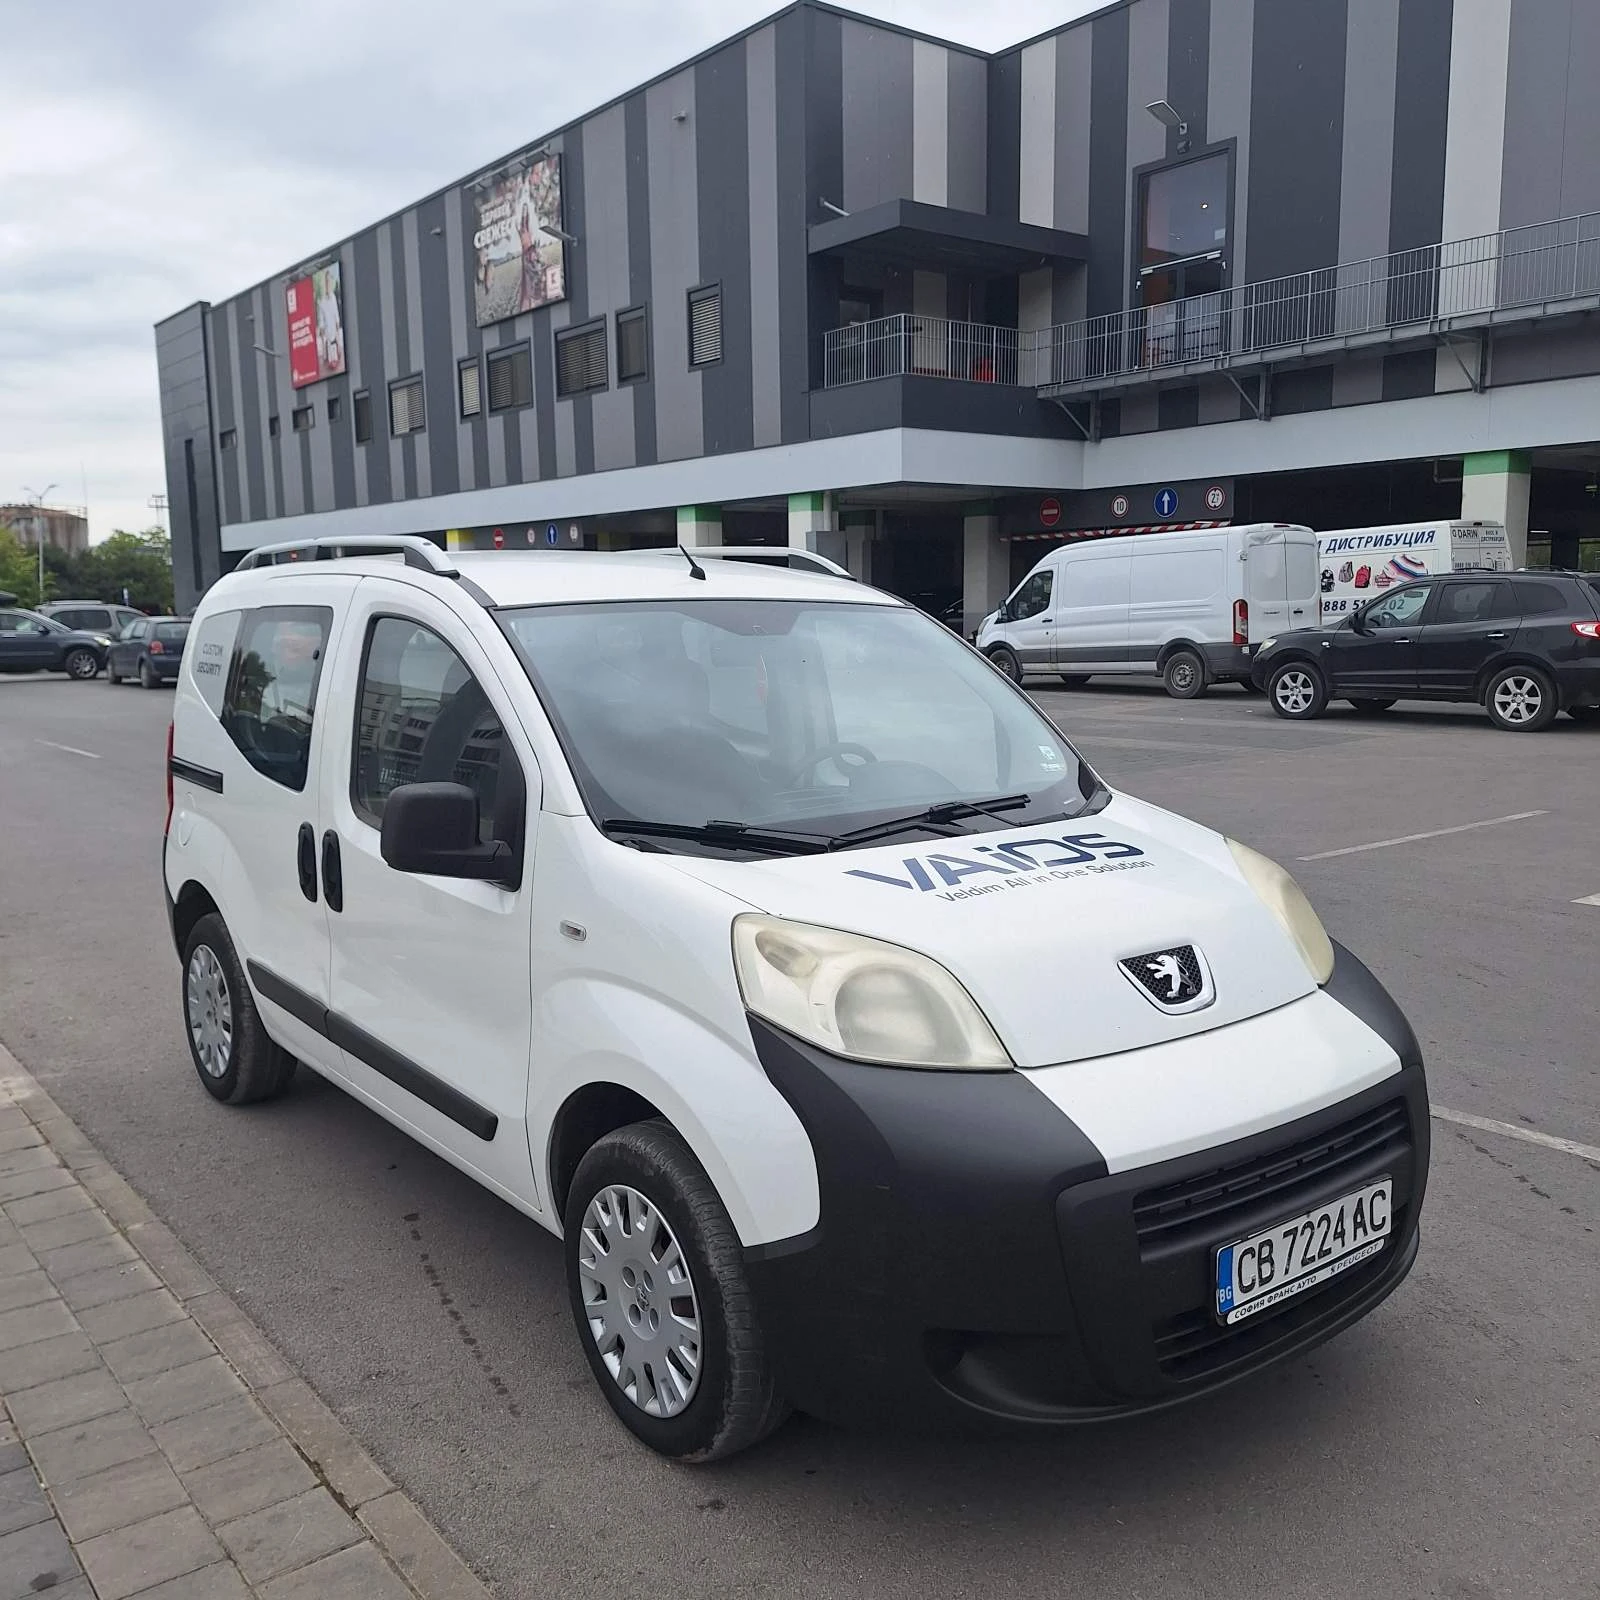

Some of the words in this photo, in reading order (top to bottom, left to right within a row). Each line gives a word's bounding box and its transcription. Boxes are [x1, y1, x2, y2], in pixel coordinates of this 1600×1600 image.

[1116, 501, 1125, 512] 10
[1325, 530, 1435, 554] ДИСТРИБУЦИЯ
[936, 884, 1004, 901] Veldim
[1004, 877, 1031, 888] All
[1028, 875, 1052, 883] in
[1049, 869, 1088, 879] One
[1085, 860, 1155, 874] Solution
[1282, 1205, 1346, 1275] 7224
[1336, 1243, 1379, 1270] PEUGEOT
[1219, 1285, 1232, 1303] BG
[1234, 1300, 1265, 1319] СОФИЯ
[1267, 1285, 1295, 1303] ФРАНС
[1296, 1275, 1317, 1290] АУТО
